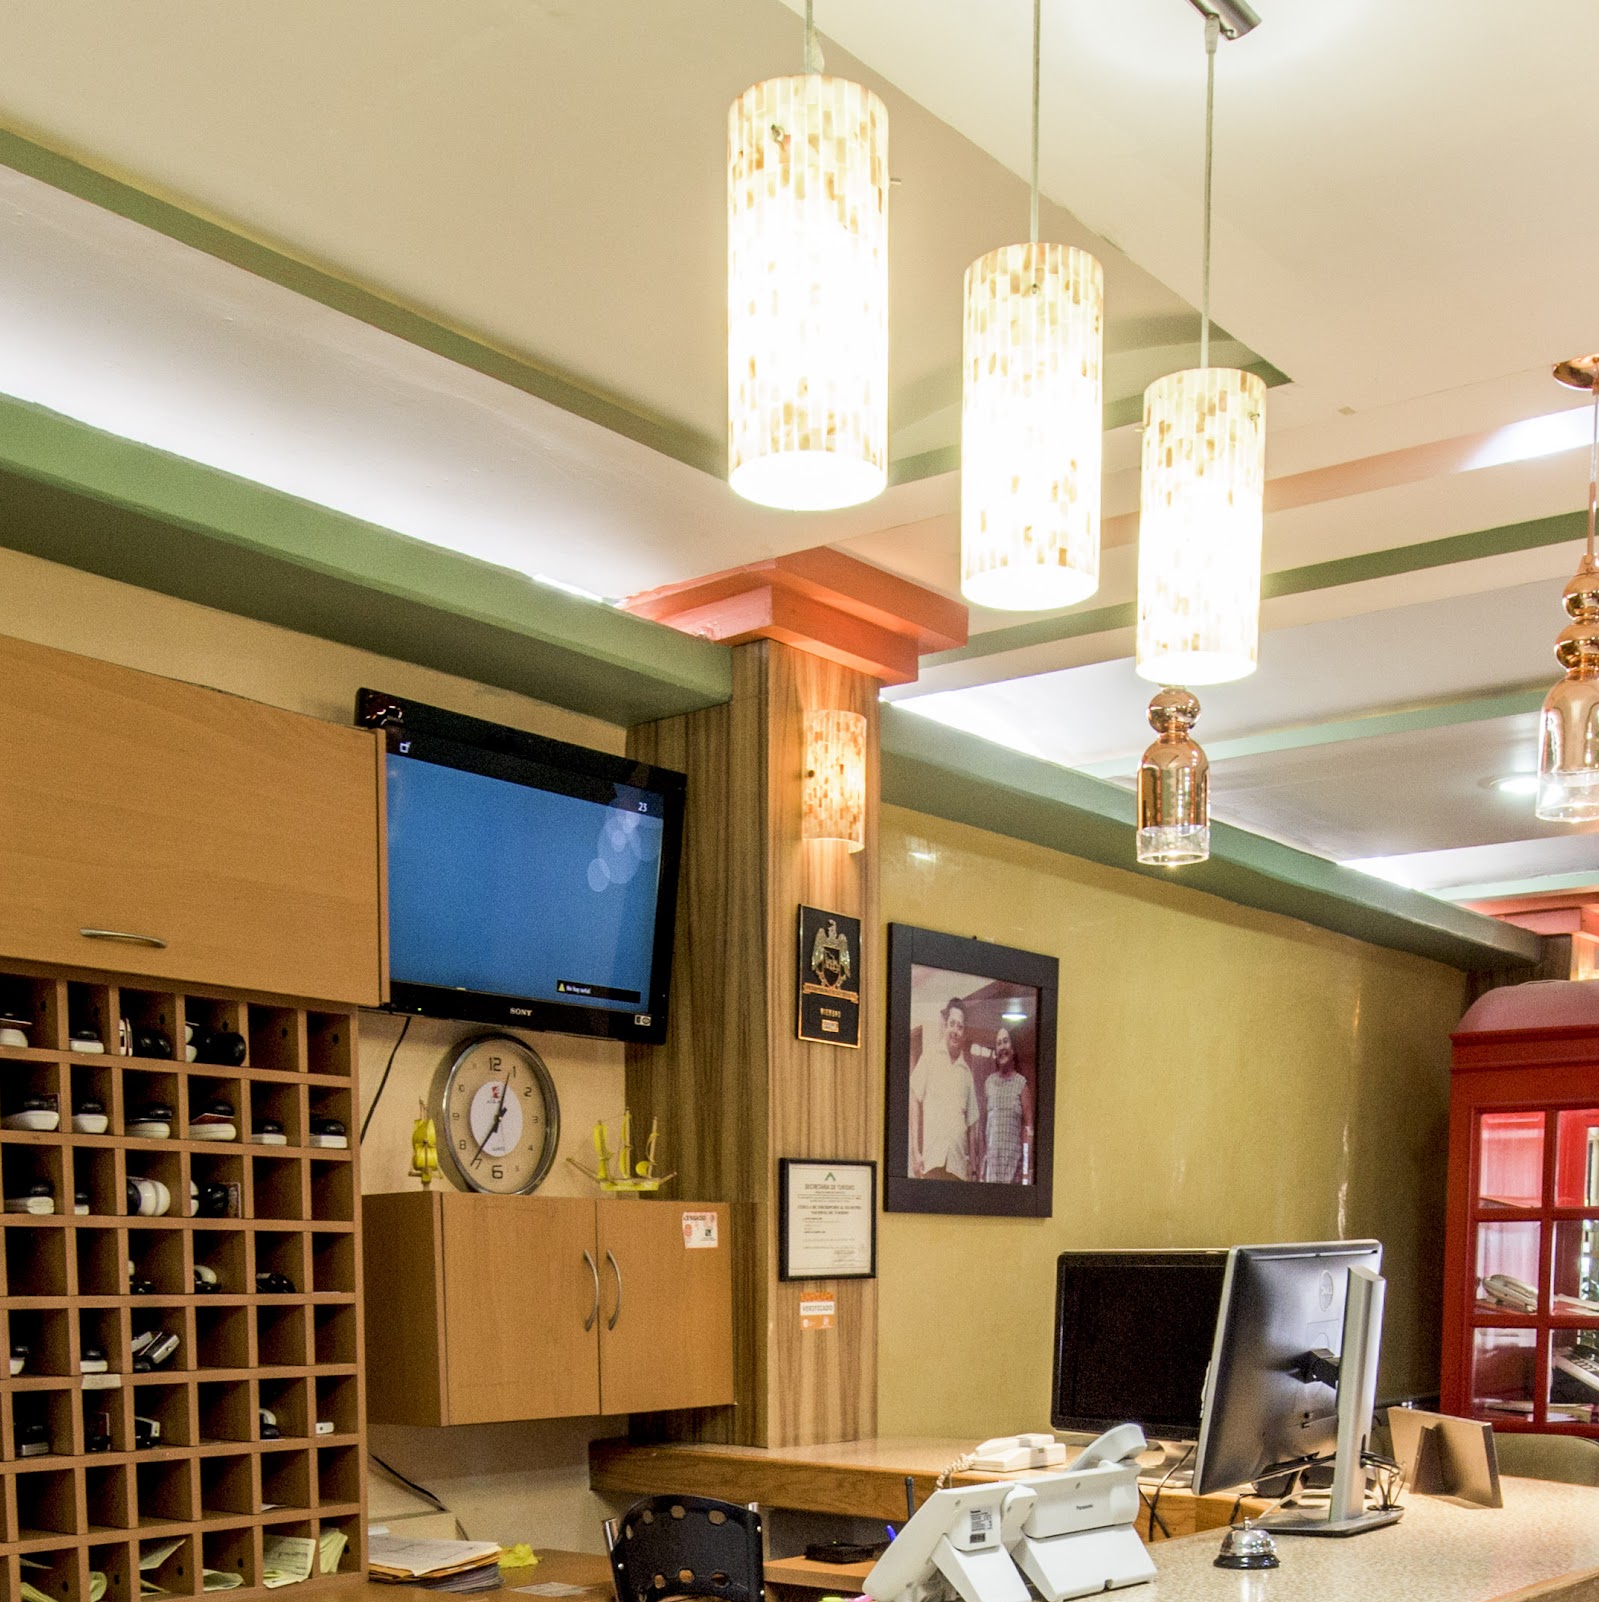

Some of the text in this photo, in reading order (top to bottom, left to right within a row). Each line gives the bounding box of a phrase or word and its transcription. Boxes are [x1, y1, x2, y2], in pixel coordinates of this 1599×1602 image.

[638, 802, 647, 812] 23
[510, 1007, 532, 1017] SONY
[489, 1057, 502, 1071] 12
[512, 1066, 517, 1078] 1
[524, 1087, 532, 1097] 2
[533, 1116, 539, 1124] 3
[459, 1140, 467, 1150] 8
[492, 1165, 504, 1179] 6
